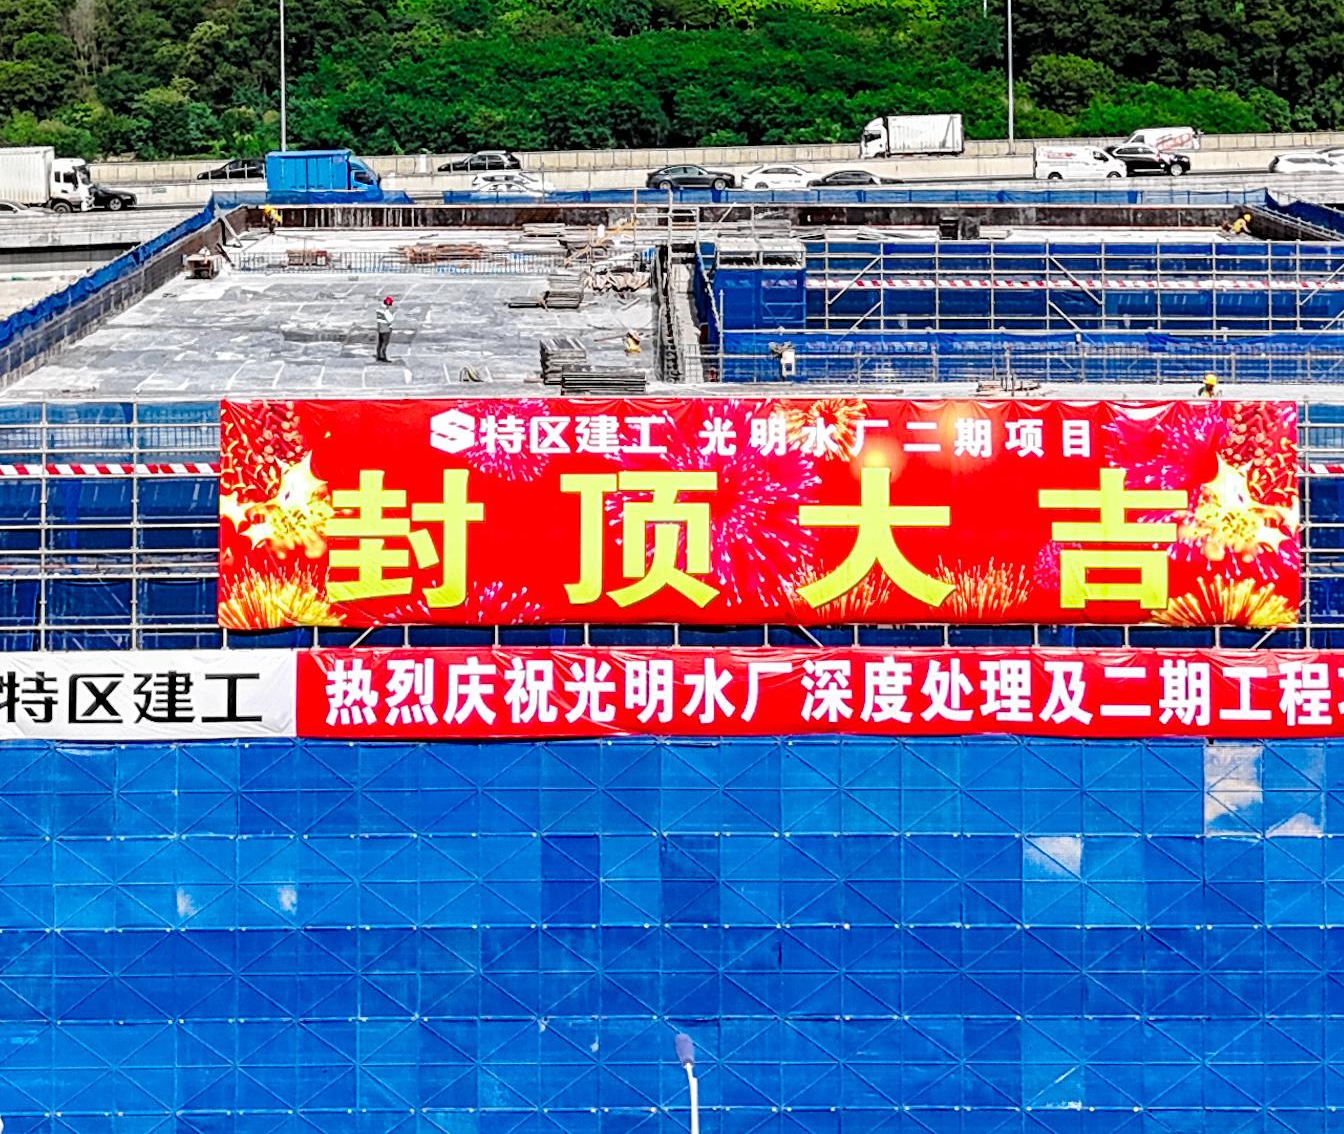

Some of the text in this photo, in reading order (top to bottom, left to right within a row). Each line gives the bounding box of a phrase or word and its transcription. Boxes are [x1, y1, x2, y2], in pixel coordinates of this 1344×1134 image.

[479, 415, 1093, 458] 特区建工 光明水厂二期项目
[329, 467, 1189, 610] 封顶大吉
[0, 671, 262, 724] 特区建工
